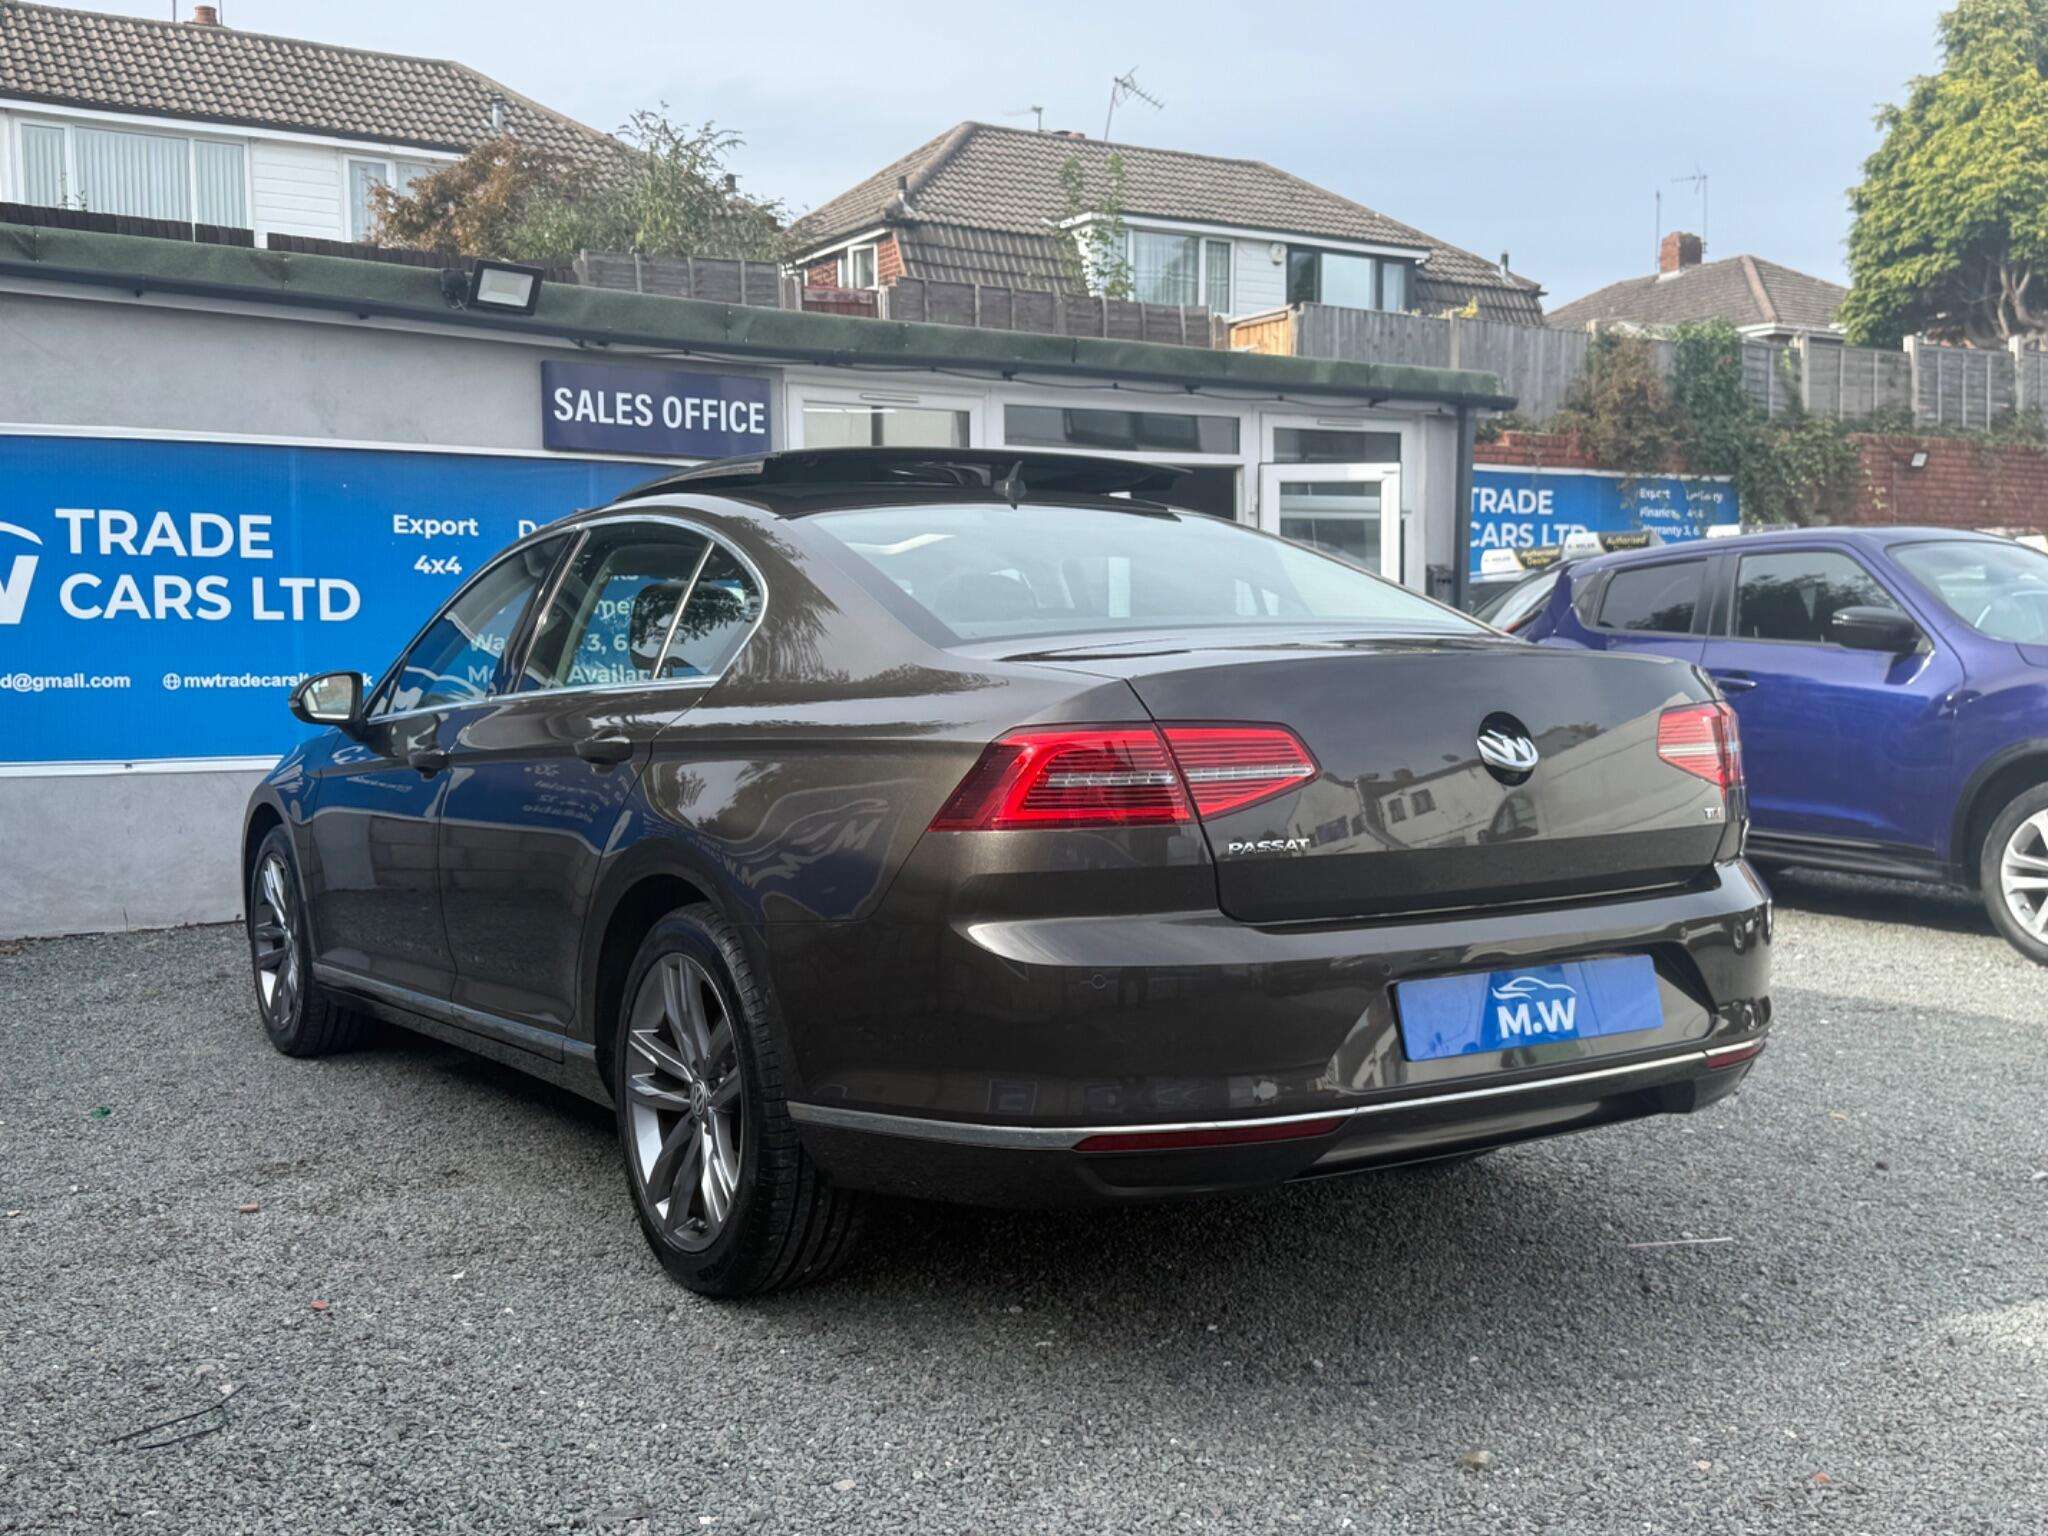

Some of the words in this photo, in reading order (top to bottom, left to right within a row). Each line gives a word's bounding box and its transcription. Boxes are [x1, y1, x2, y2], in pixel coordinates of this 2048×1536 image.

[553, 386, 654, 428] SALES
[662, 395, 767, 435] OFFICE
[1470, 487, 1554, 515] TRADE
[55, 507, 274, 559] TRADE
[392, 514, 480, 542] Export
[1470, 521, 1534, 548] CARS
[413, 555, 463, 575] 4x4
[59, 572, 233, 621] CARS
[251, 576, 362, 622] LTD
[1228, 838, 1311, 855] PASSAT
[1497, 996, 1577, 1041] M.W
